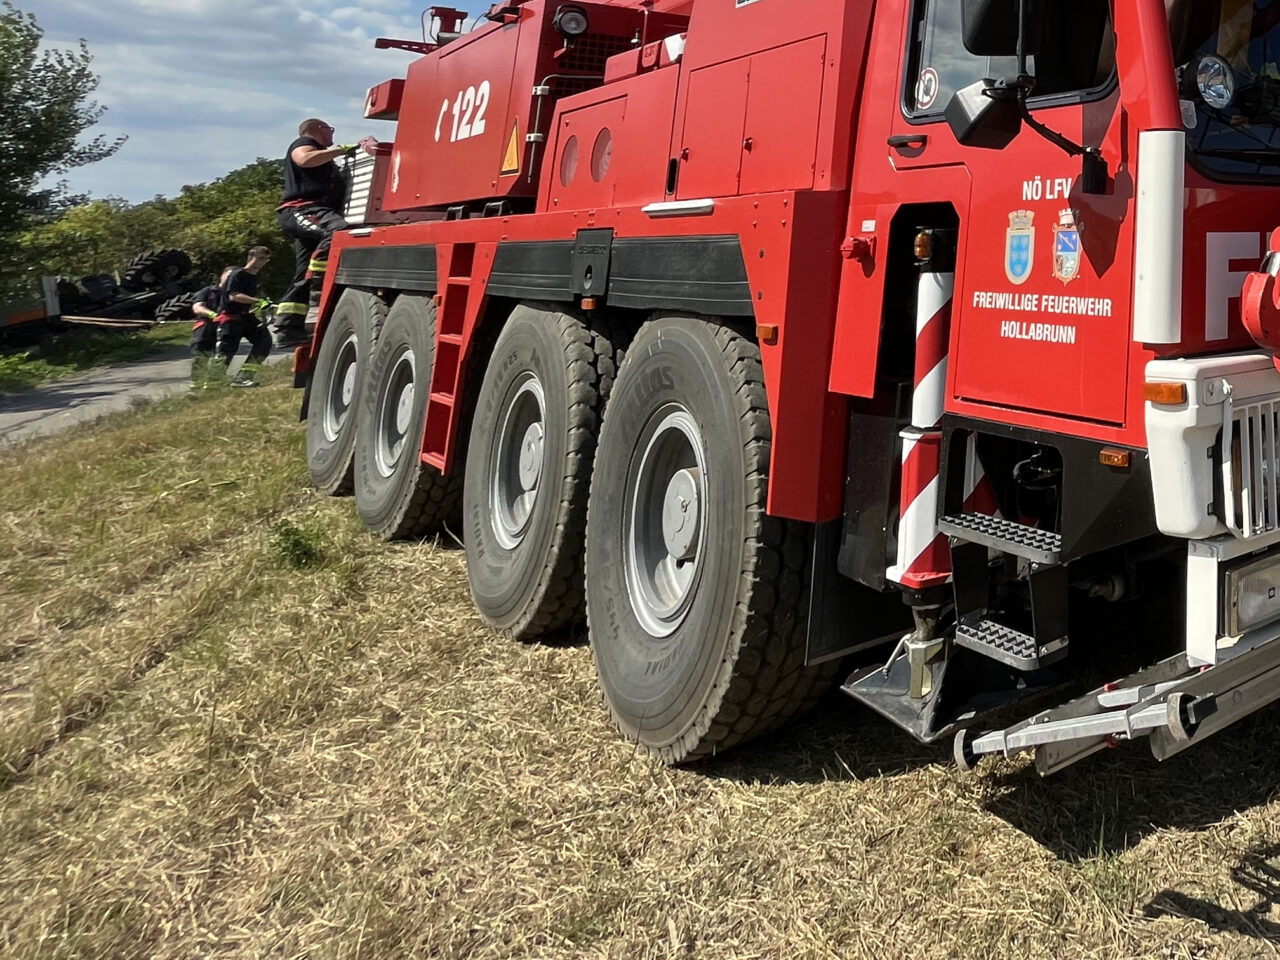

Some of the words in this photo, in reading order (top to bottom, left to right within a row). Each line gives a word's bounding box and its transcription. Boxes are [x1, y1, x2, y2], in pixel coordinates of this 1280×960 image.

[450, 80, 490, 142] 122
[1022, 175, 1042, 201] NÖ
[1045, 178, 1072, 200] LFV
[1204, 231, 1271, 342] F
[973, 291, 1038, 312] FREIWILLIGE
[1041, 295, 1112, 318] FEUERWEHR
[1000, 320, 1076, 344] HOLLABRUNN
